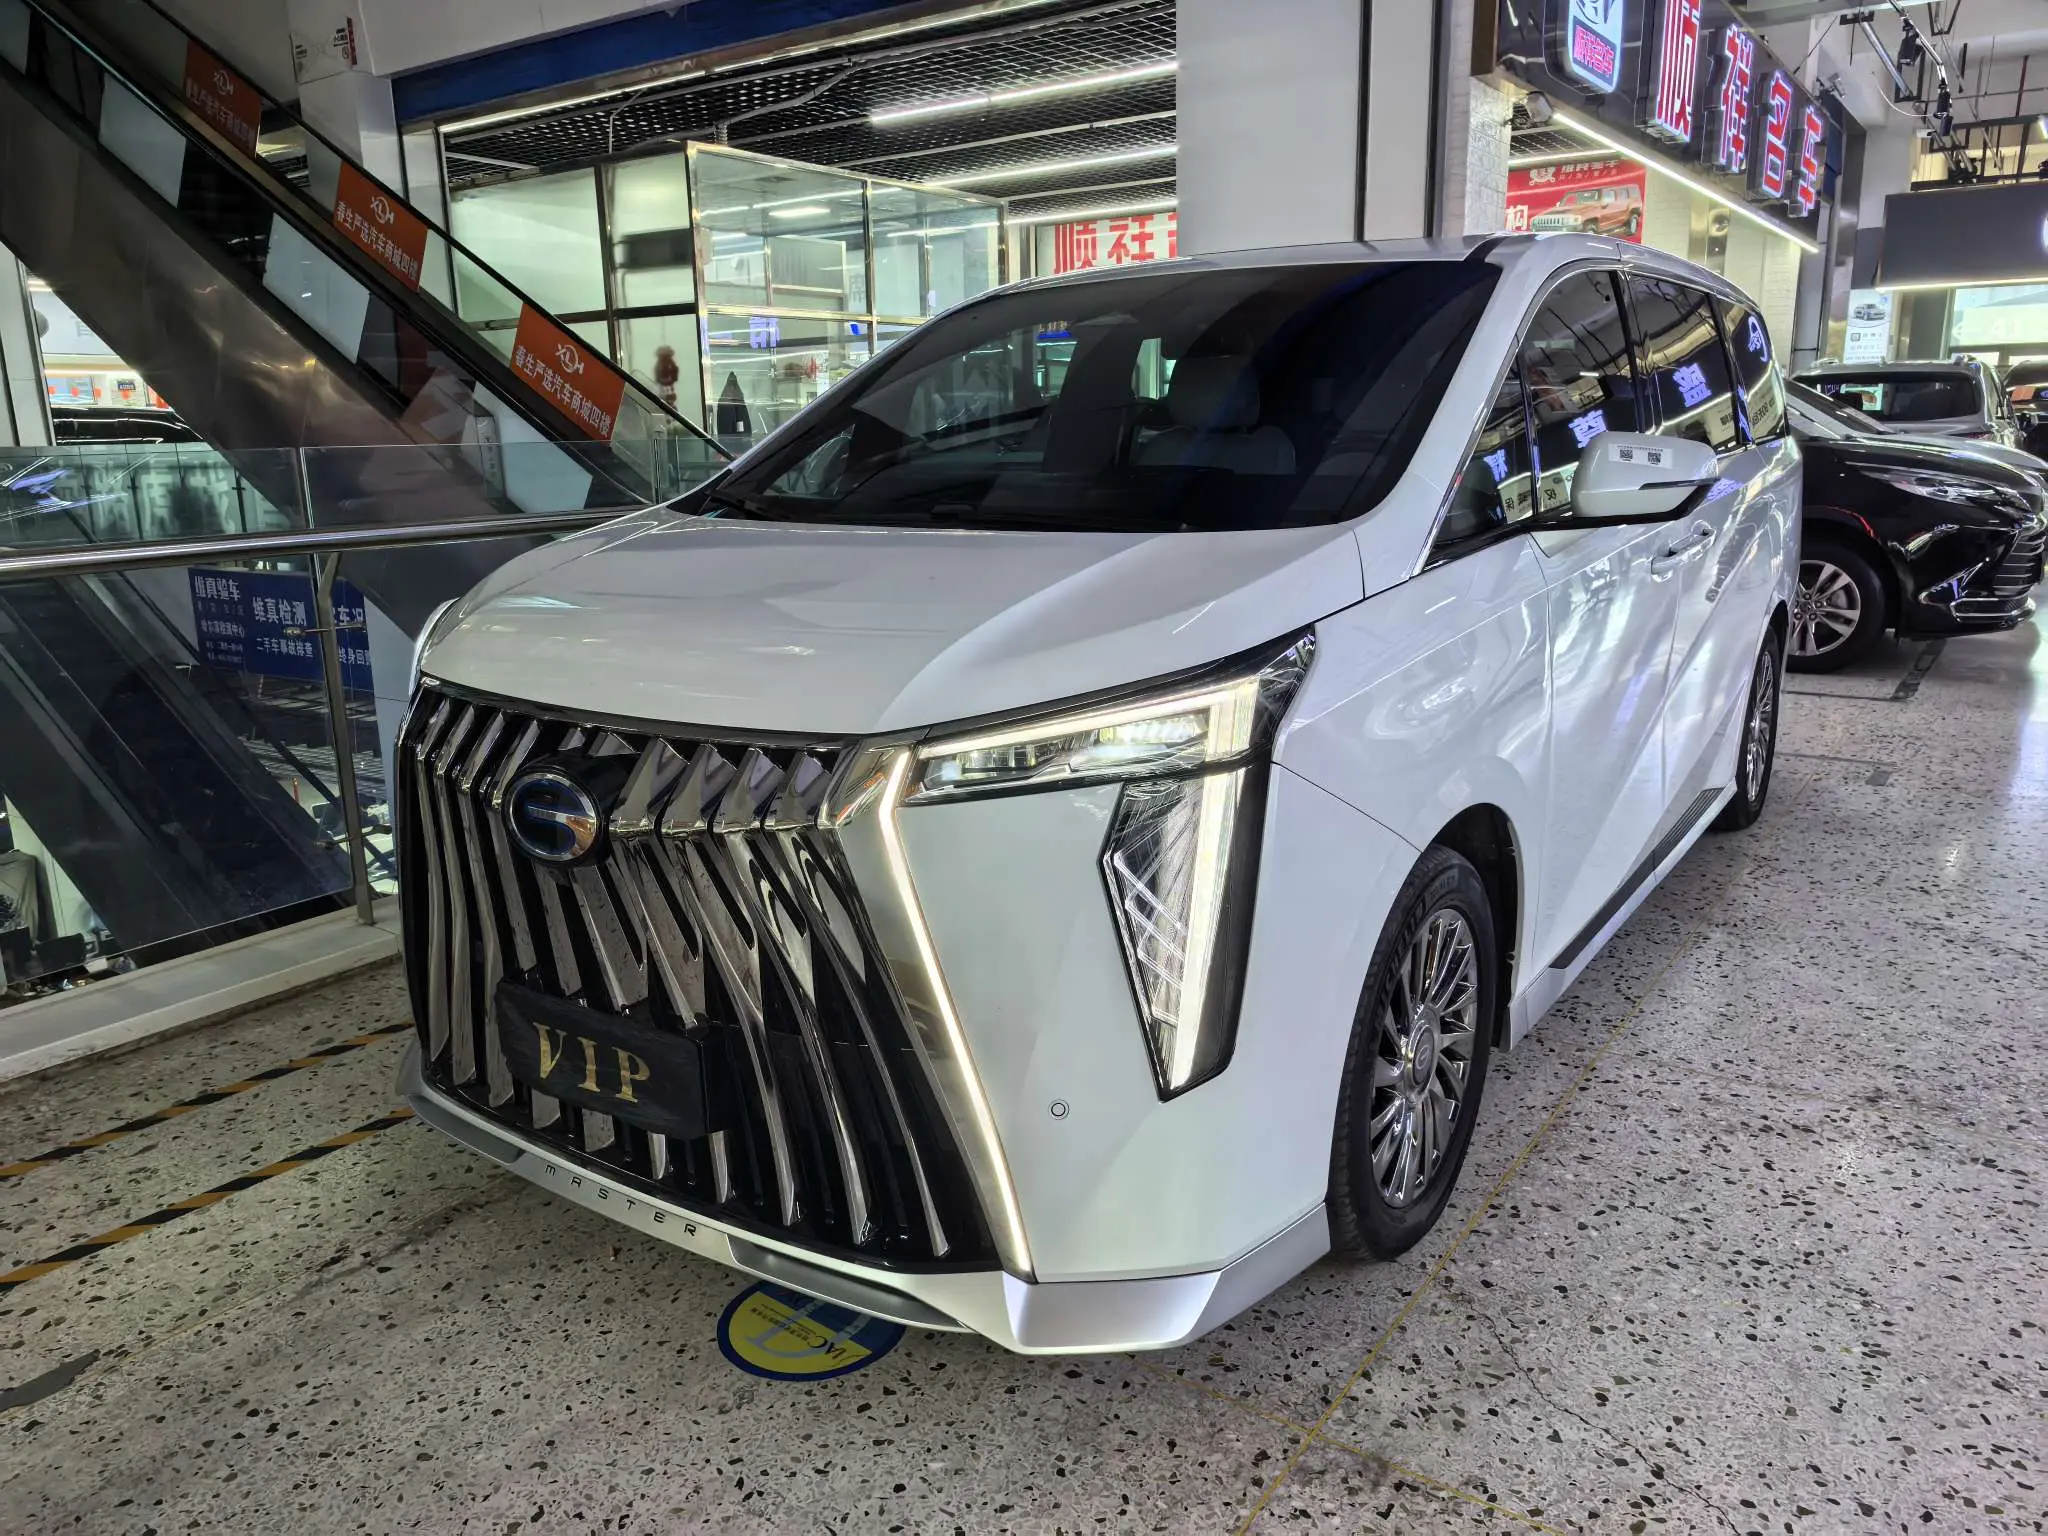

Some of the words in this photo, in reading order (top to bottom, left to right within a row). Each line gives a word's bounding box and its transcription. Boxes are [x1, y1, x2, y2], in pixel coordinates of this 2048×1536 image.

[1656, 0, 1823, 218] 顺祥名车
[532, 1021, 651, 1103] VIP
[544, 1164, 697, 1237] MASTER
